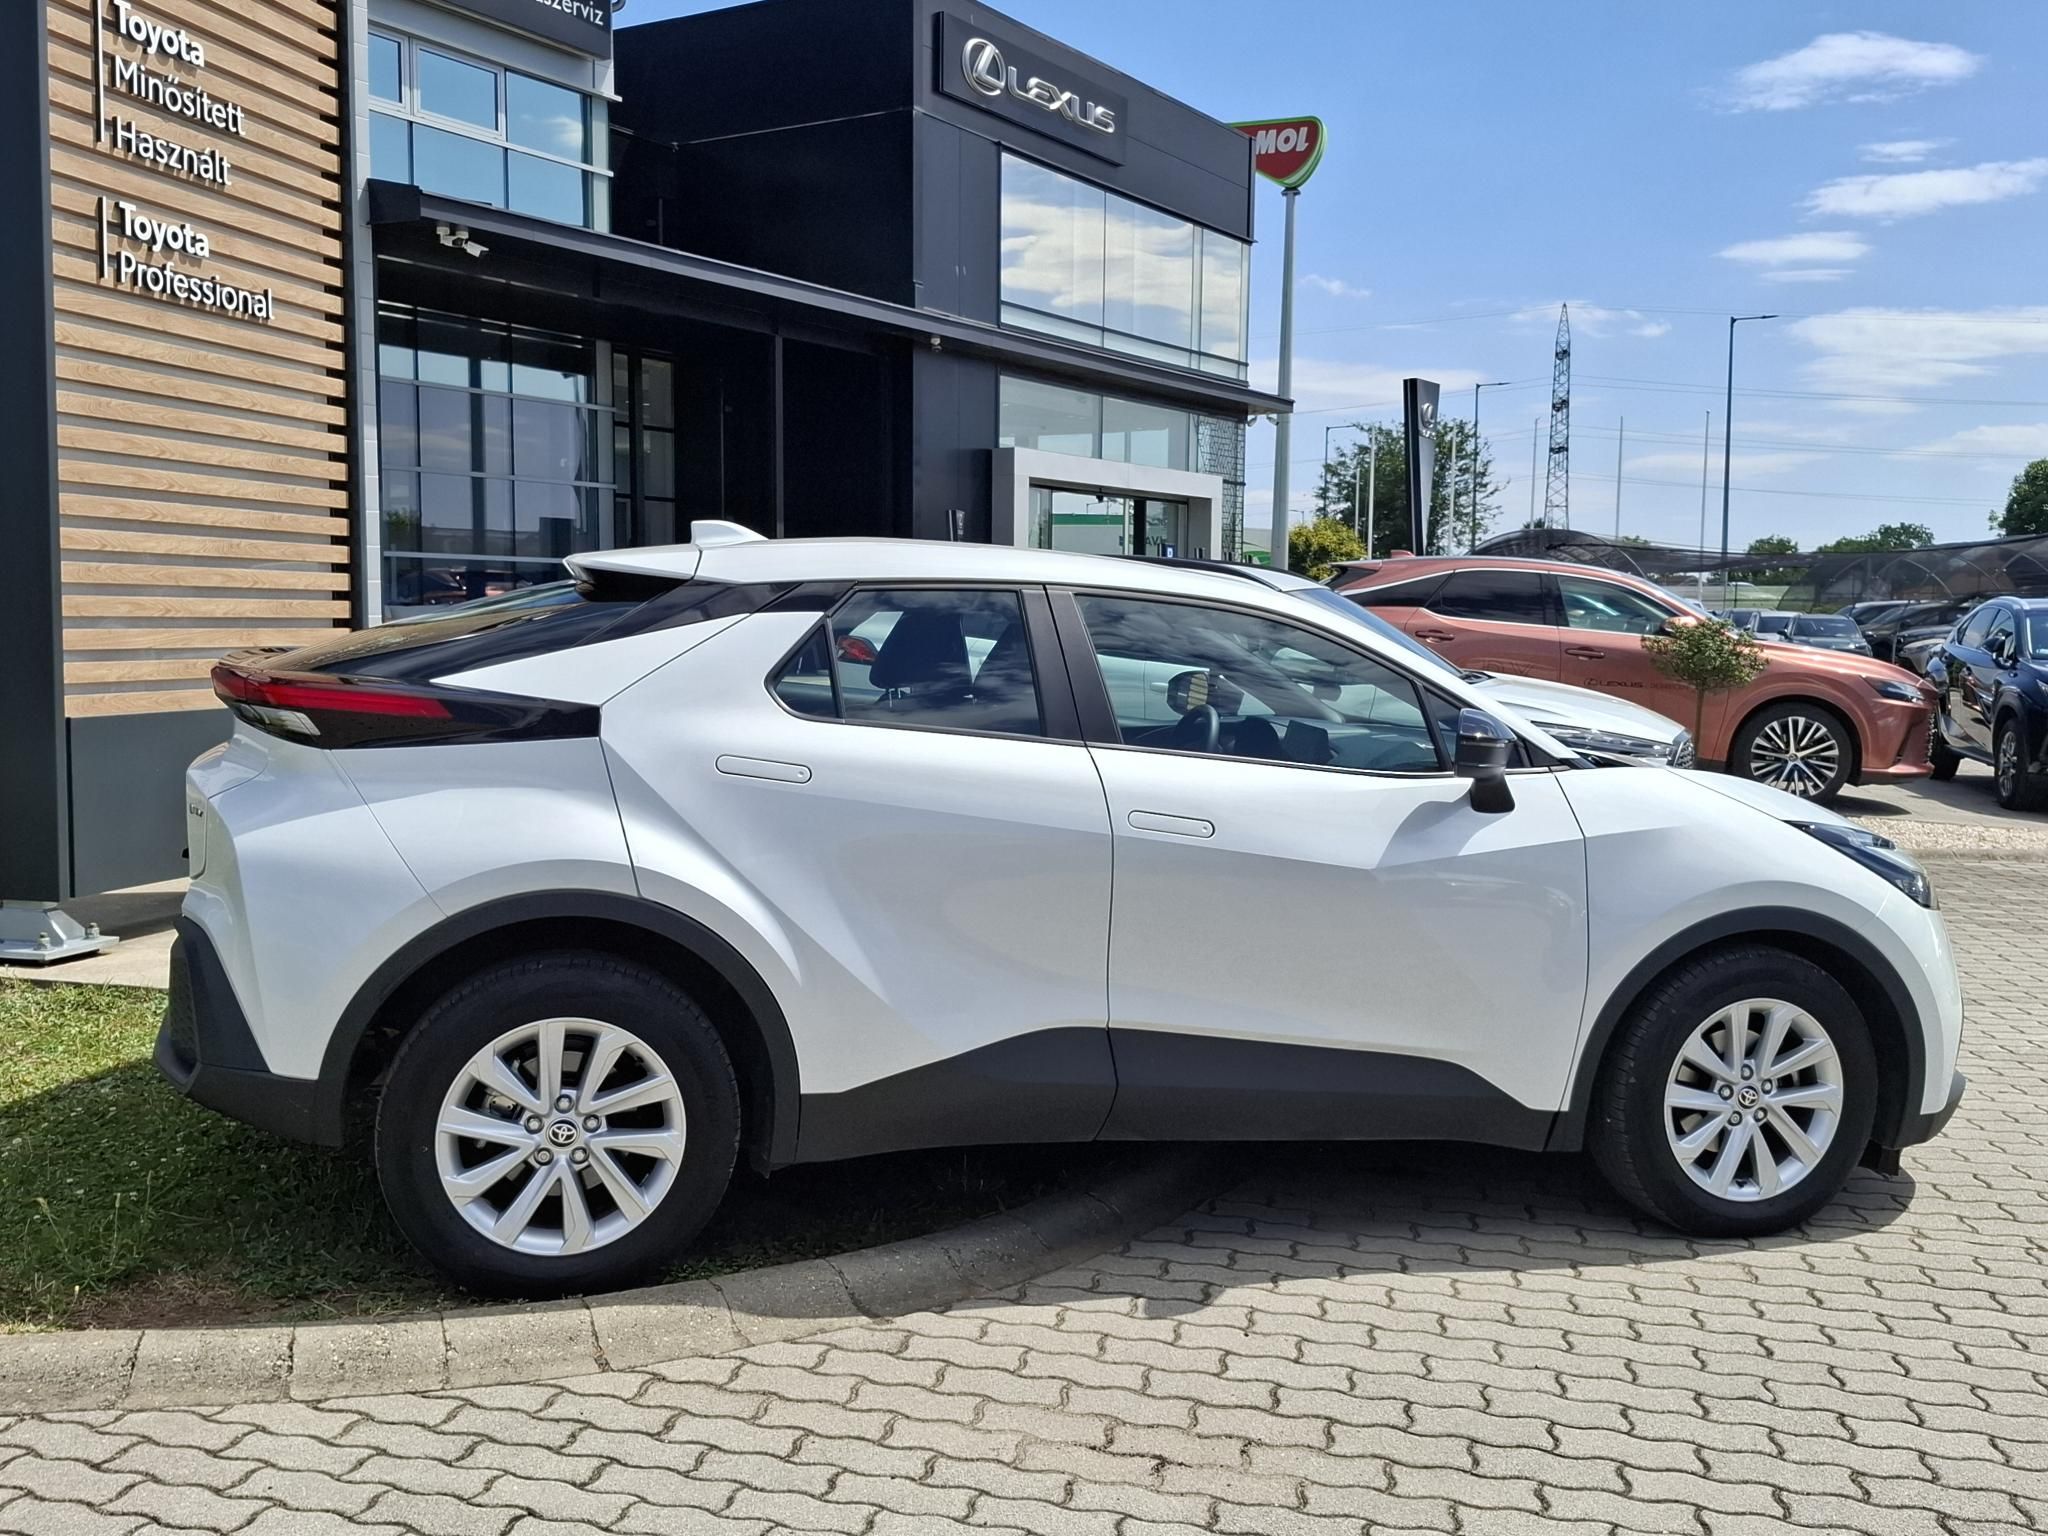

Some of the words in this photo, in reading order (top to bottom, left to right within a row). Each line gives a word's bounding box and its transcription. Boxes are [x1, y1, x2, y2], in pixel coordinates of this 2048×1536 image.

[113, 1, 205, 68] Toyota
[115, 55, 246, 136] Minősített
[1007, 65, 1116, 134] LEXUS
[116, 115, 232, 185] Használt
[1255, 127, 1309, 155] MOL
[119, 201, 210, 258] Toyota
[120, 251, 275, 320] Professional
